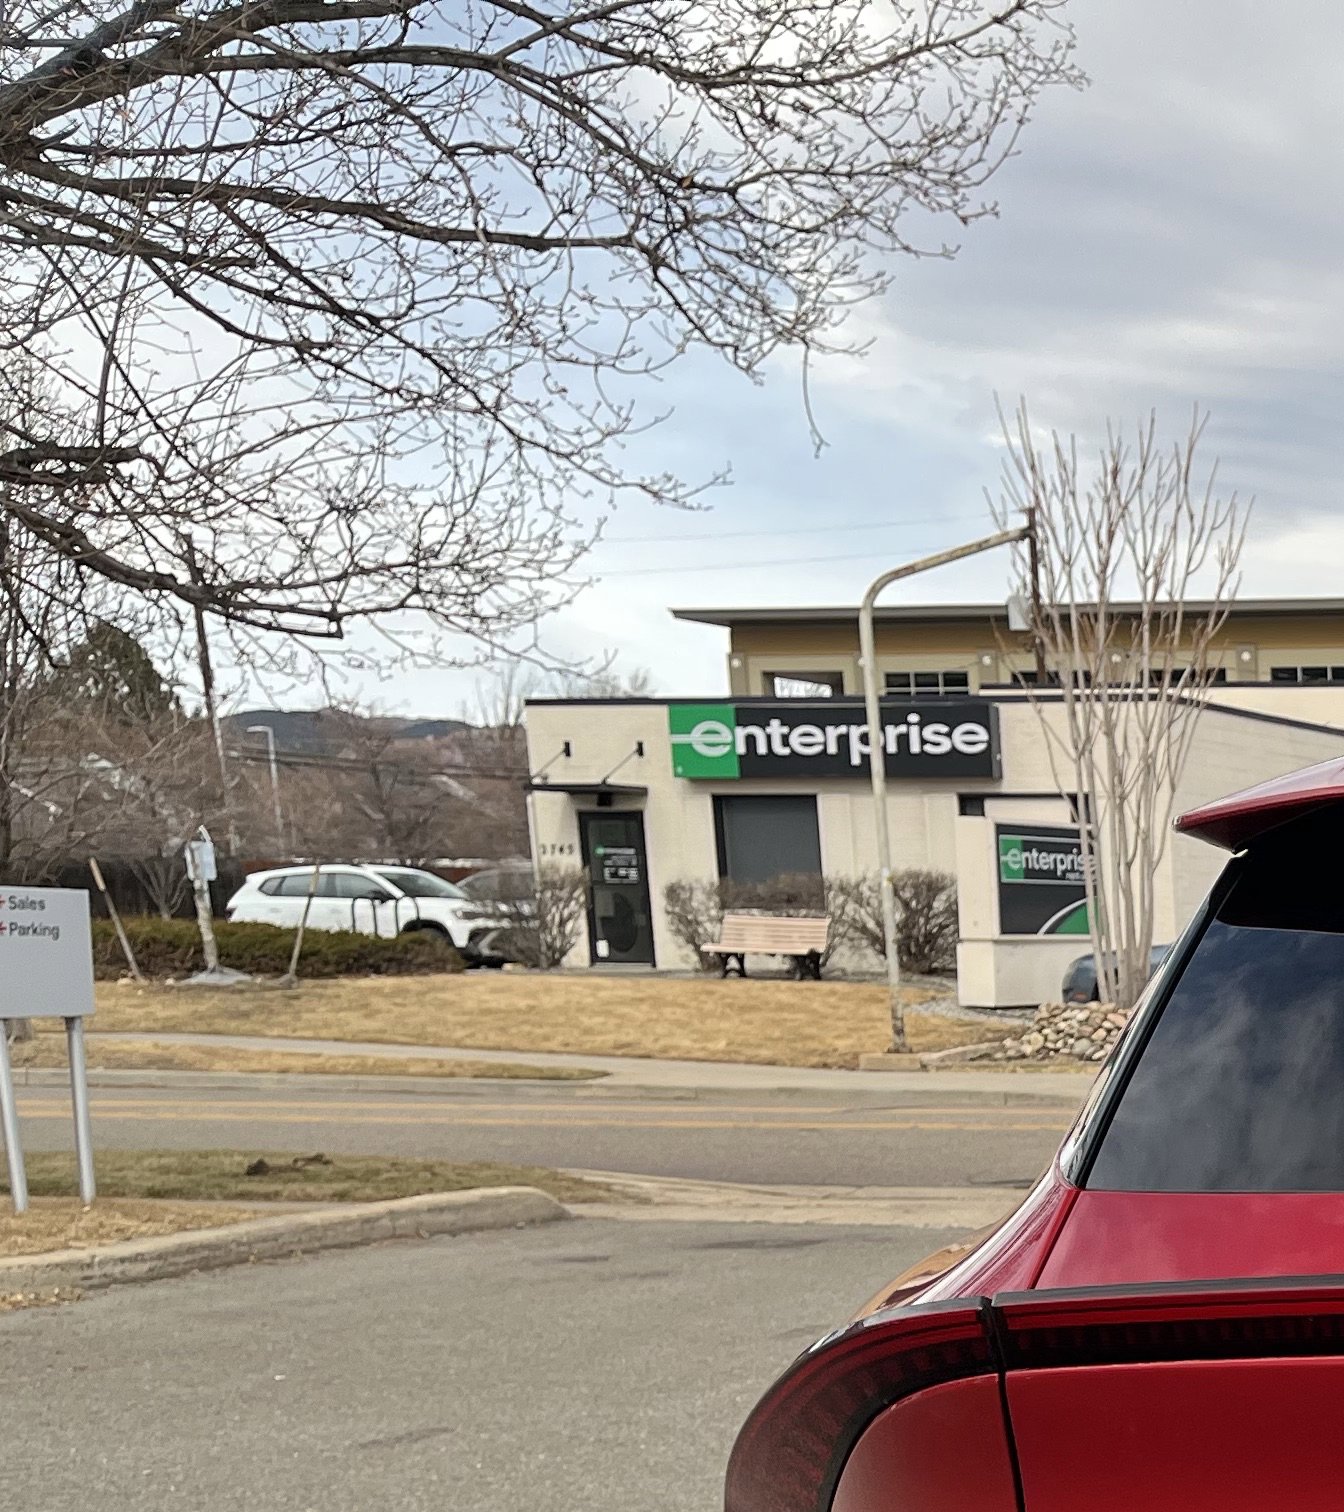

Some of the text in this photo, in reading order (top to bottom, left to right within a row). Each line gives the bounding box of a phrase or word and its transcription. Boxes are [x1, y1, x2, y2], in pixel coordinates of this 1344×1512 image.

[690, 713, 990, 766] enterprise
[8, 894, 46, 911] Sales
[9, 921, 60, 941] Parking
